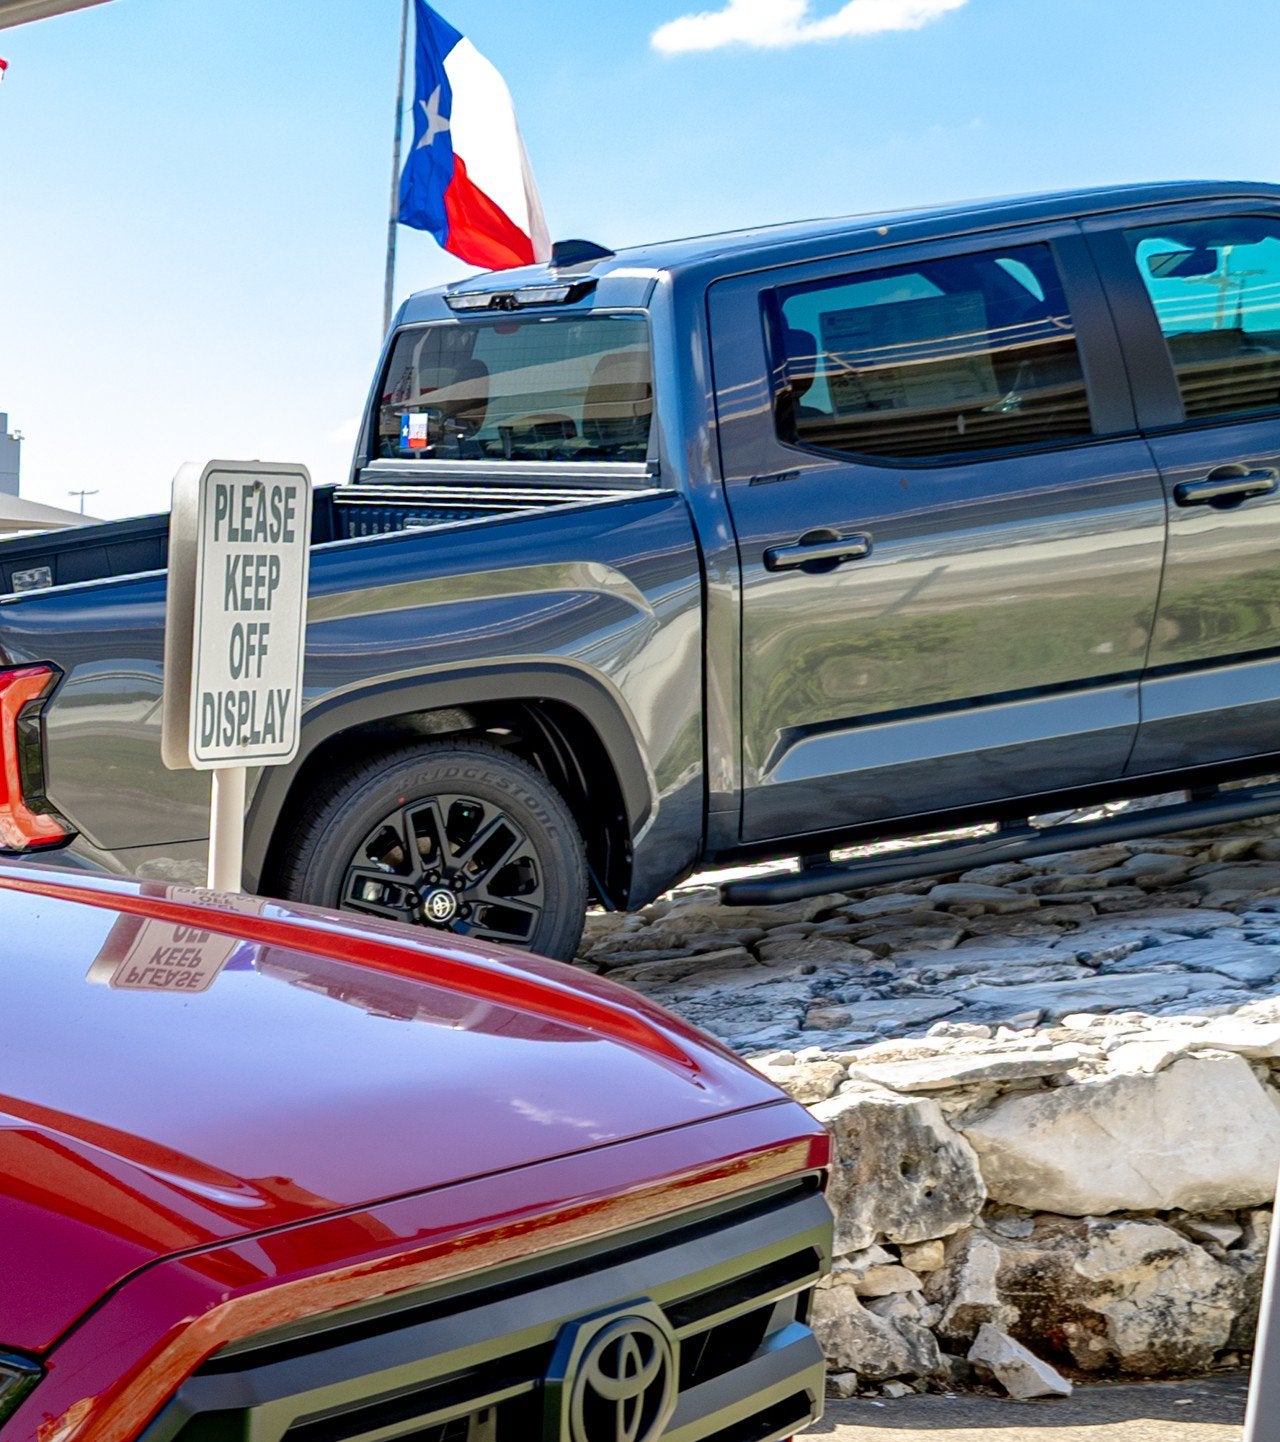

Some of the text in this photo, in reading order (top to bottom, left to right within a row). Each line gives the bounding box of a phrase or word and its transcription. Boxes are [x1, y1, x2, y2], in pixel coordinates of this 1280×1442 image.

[214, 483, 297, 543] PLEASE
[224, 554, 281, 611] KEEP
[229, 622, 270, 680] OFF
[200, 688, 292, 748] DISPLAY
